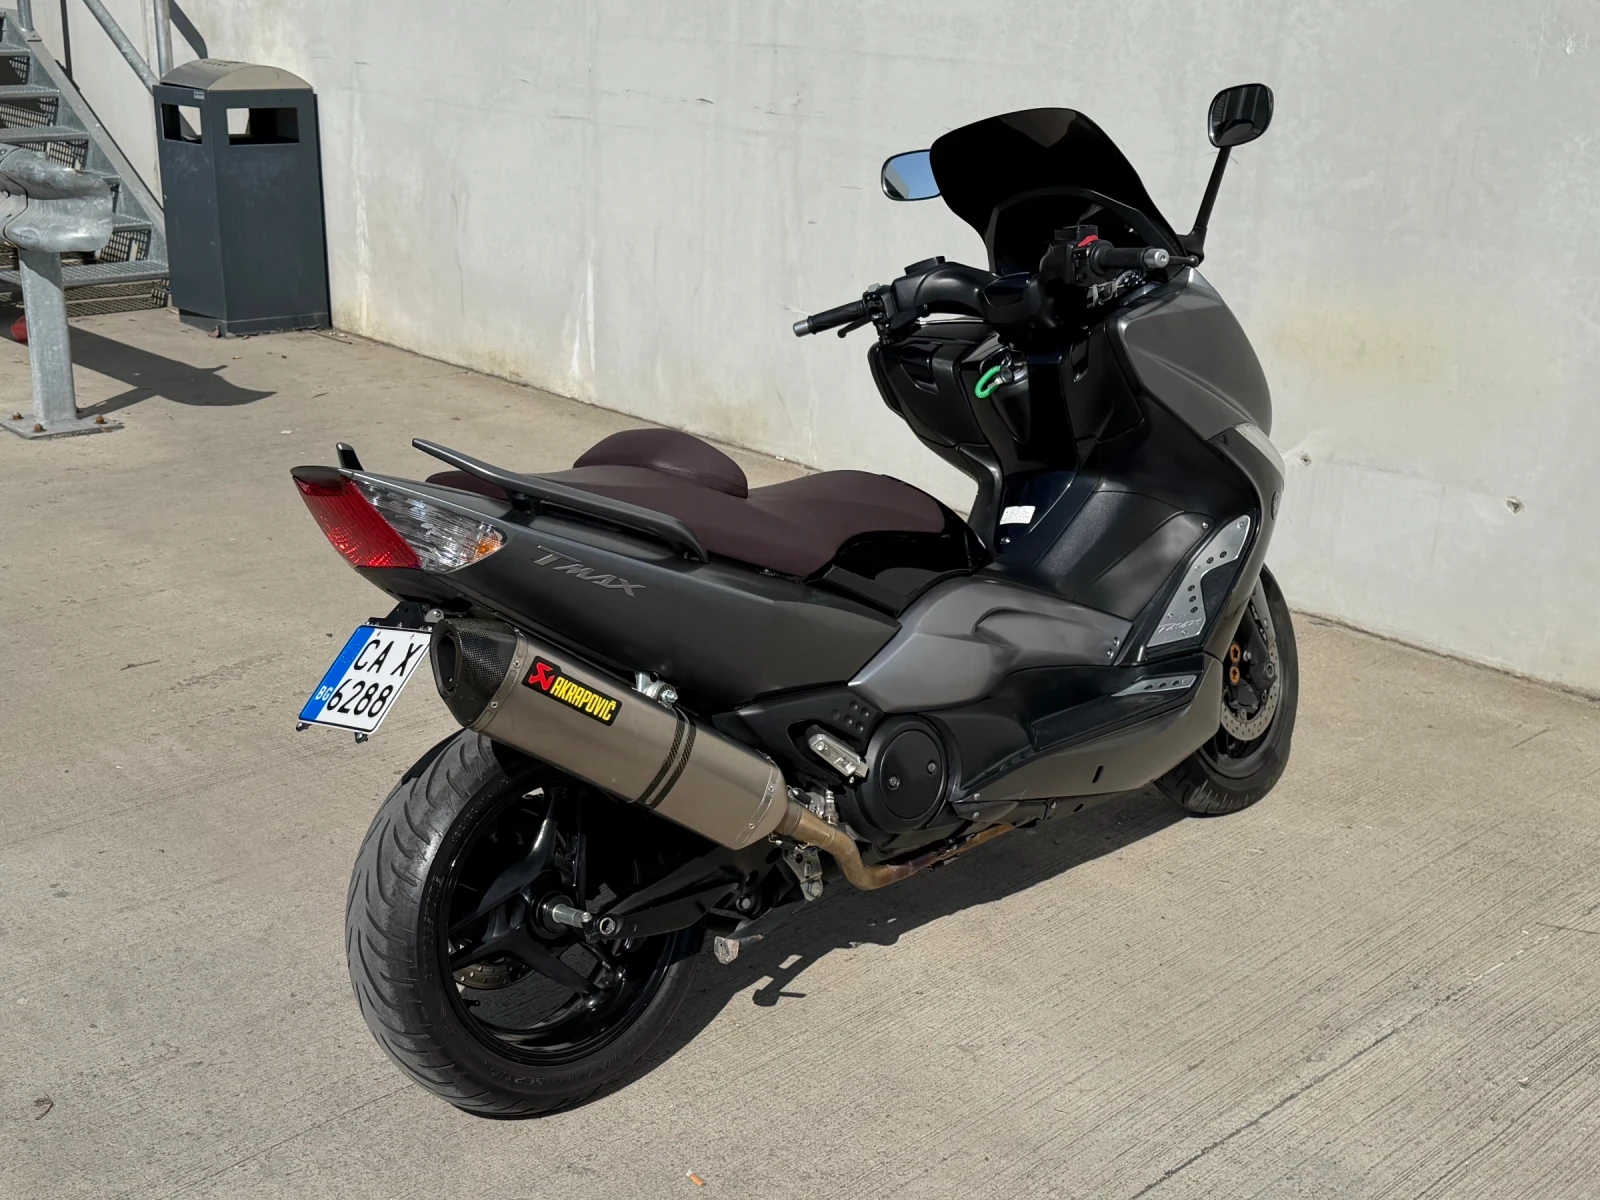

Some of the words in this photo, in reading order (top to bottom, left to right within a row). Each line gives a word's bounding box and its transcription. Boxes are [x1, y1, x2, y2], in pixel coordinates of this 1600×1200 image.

[533, 545, 647, 598] TMAX
[353, 639, 395, 674] CA
[389, 643, 424, 677] X
[314, 685, 334, 702] BG
[326, 678, 394, 718] 6288
